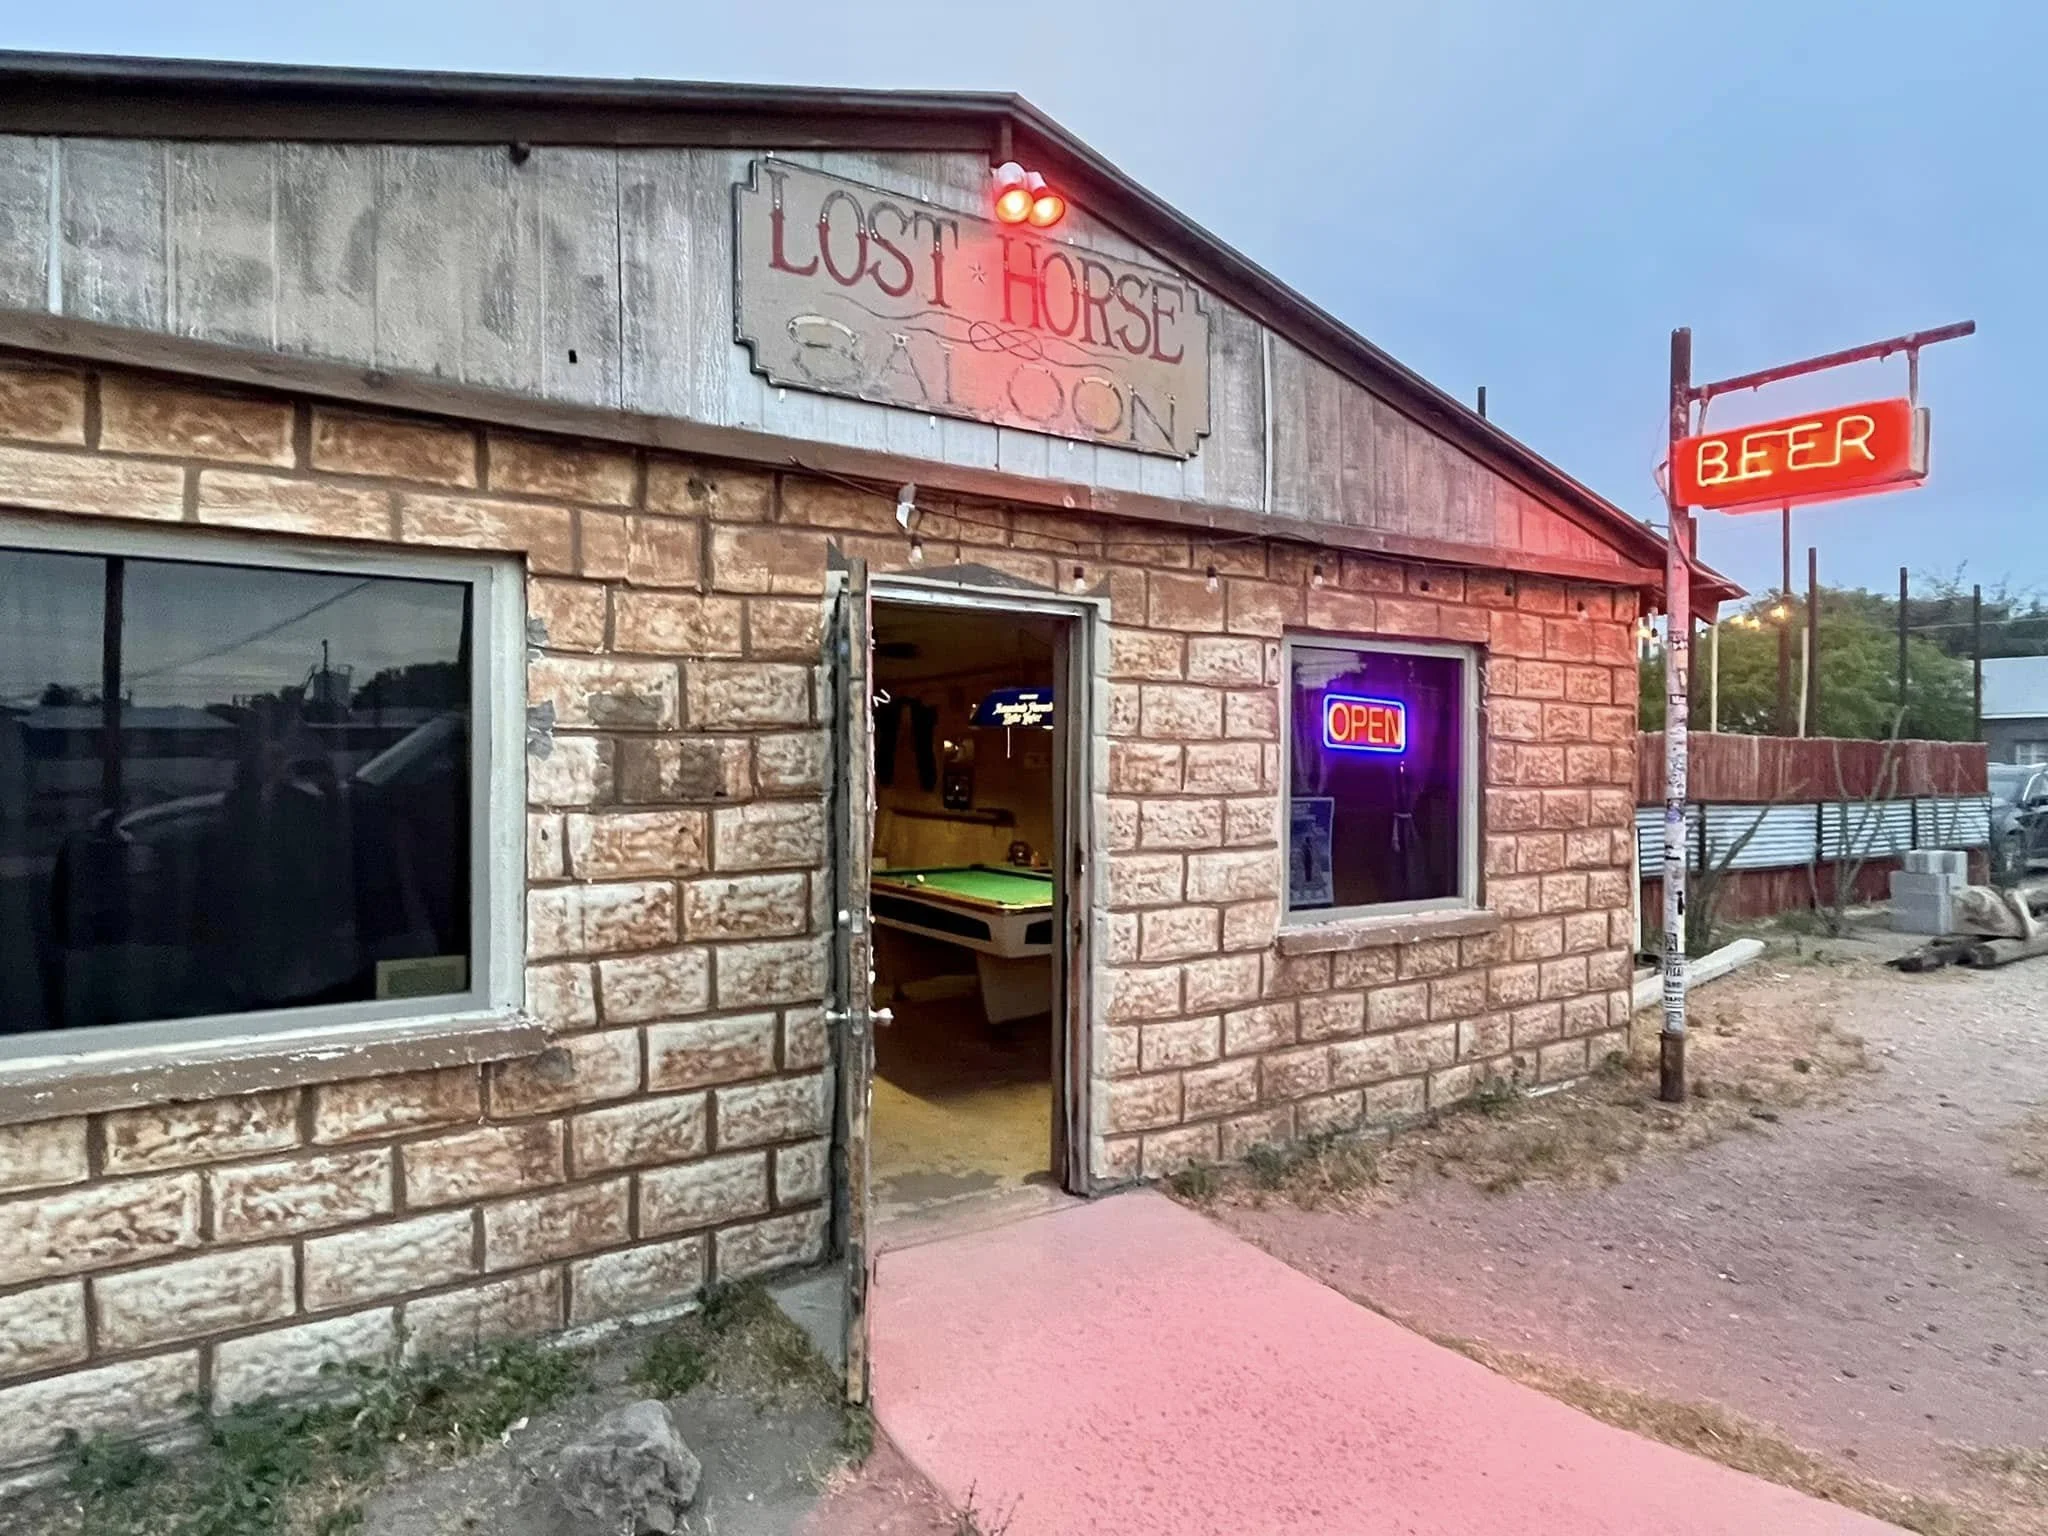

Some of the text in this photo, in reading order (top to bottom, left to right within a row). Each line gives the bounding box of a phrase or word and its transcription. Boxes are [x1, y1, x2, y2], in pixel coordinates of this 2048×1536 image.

[768, 169, 1186, 365] LOST HORSE
[1697, 414, 1876, 487] BEER
[1328, 702, 1402, 744] OPEN
